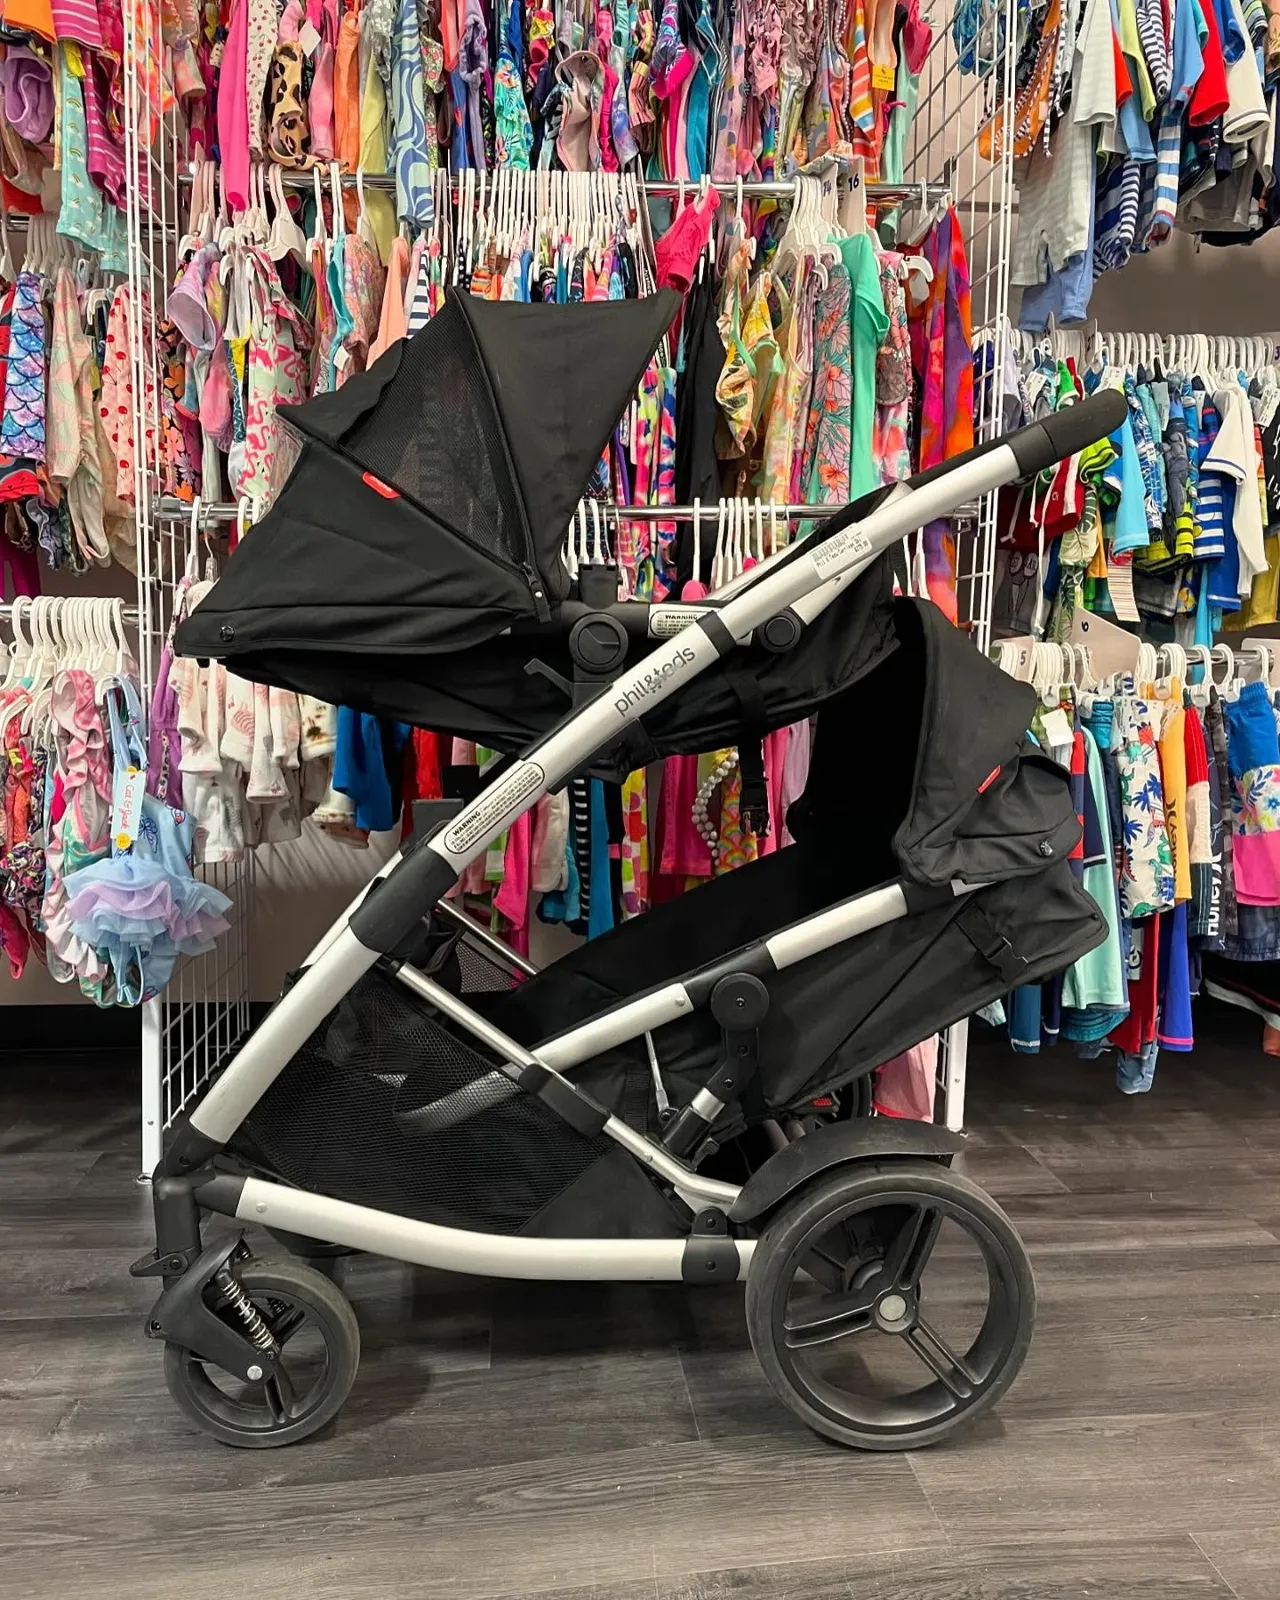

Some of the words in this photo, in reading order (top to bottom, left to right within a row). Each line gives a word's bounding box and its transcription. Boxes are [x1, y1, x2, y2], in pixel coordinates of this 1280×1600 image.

[848, 172, 860, 192] 16
[1020, 650, 1027, 665] 5
[452, 810, 481, 837] WARNING
